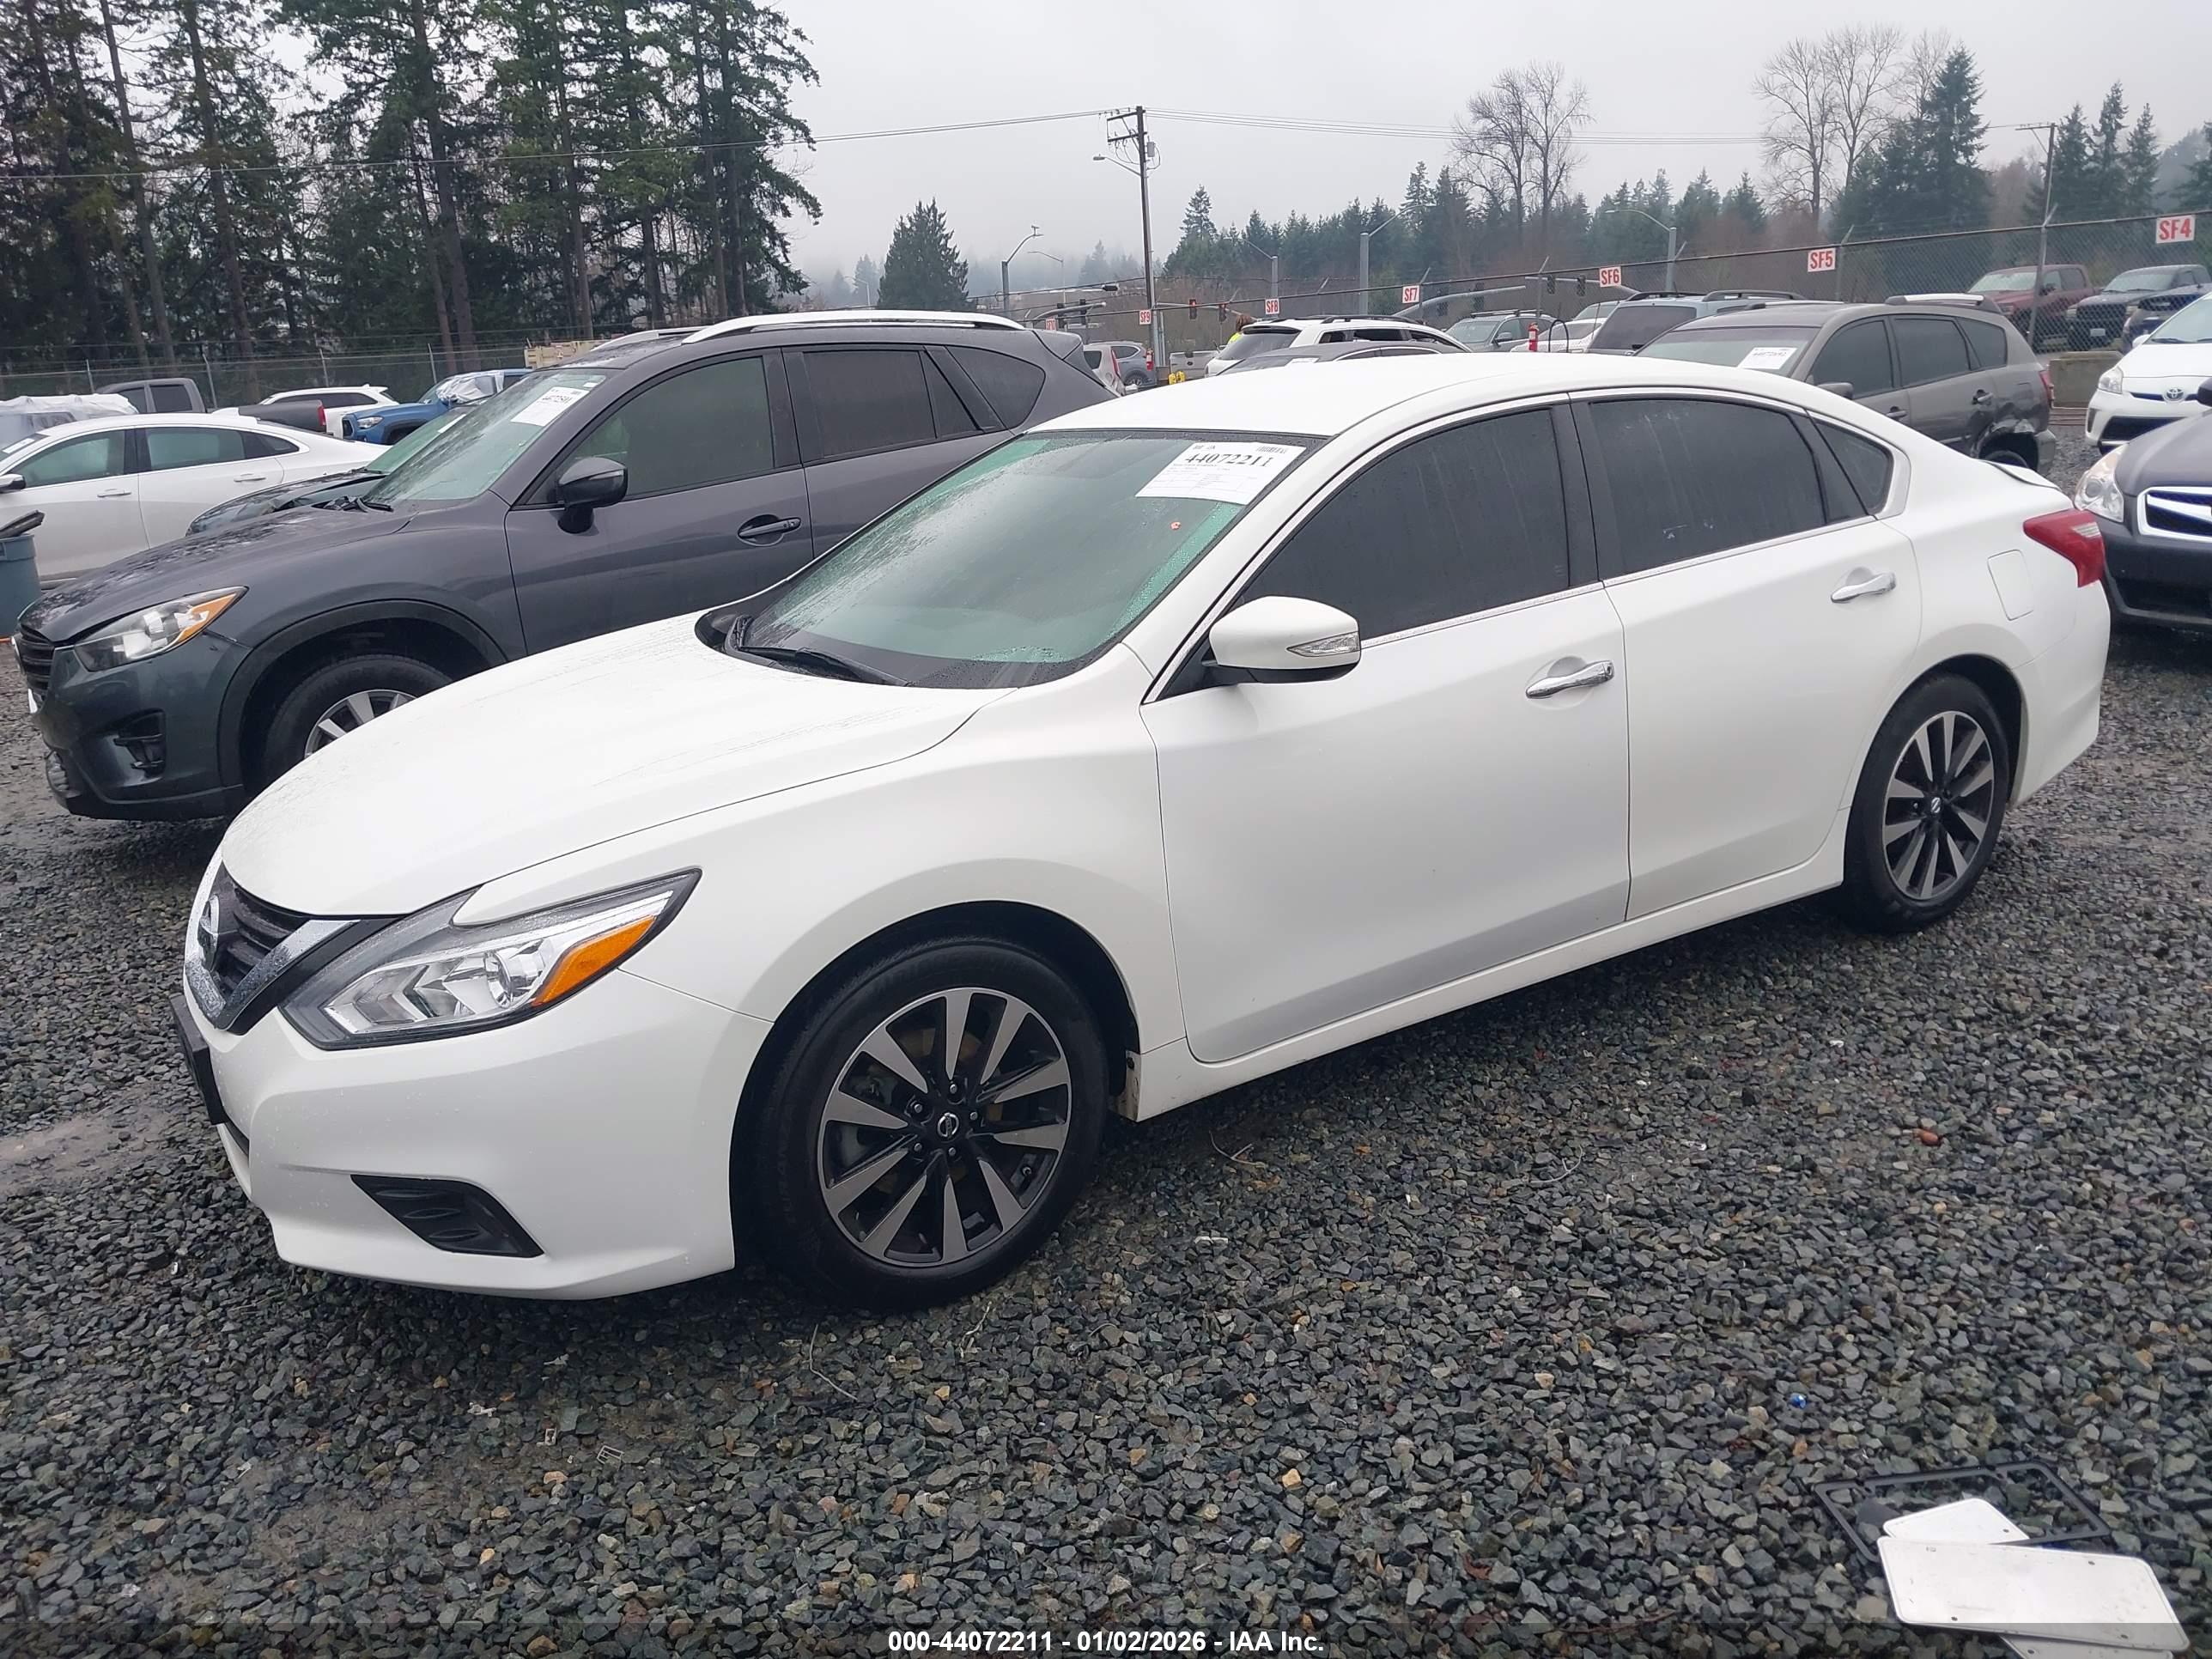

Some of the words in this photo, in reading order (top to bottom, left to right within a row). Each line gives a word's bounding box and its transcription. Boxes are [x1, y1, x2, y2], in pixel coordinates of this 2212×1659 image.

[2159, 218, 2191, 240] SF4
[1810, 251, 1833, 269] SF5
[1601, 269, 1620, 285] SF6
[1404, 288, 1418, 301] SF7
[1185, 453, 1273, 467] 44072211
